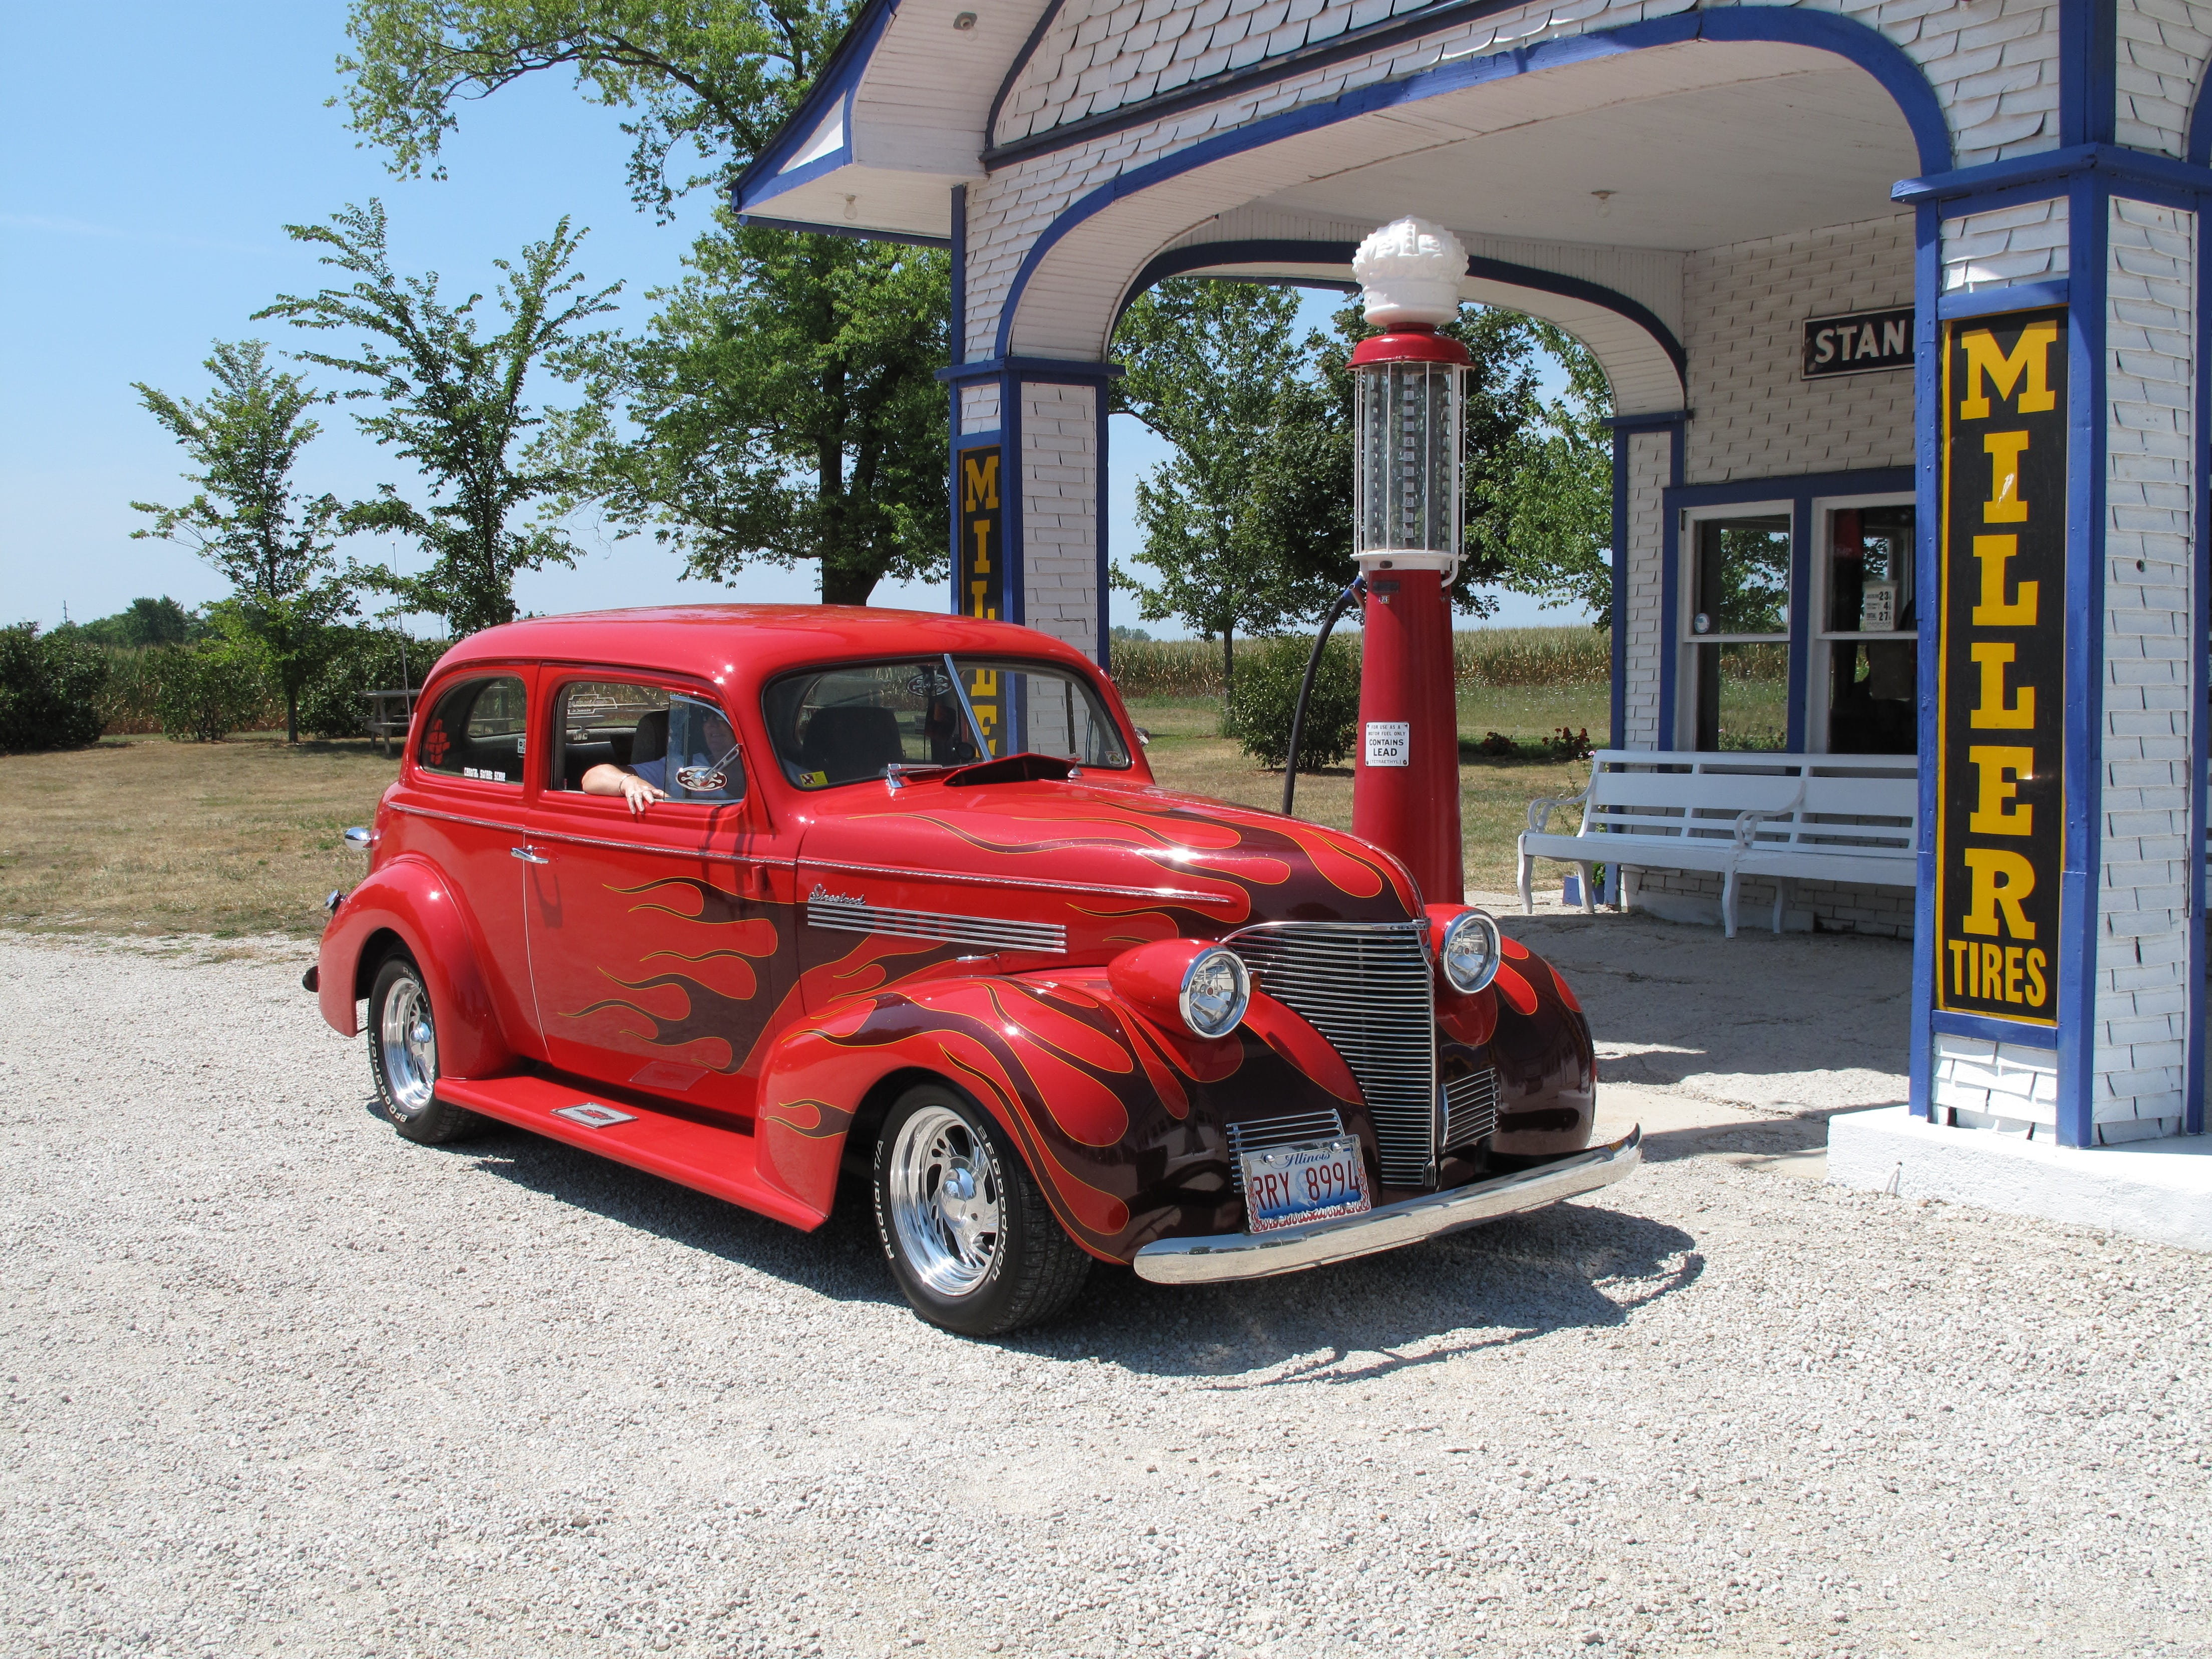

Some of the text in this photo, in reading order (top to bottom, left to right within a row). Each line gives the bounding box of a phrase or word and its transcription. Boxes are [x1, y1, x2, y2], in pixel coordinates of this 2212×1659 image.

[1815, 320, 1914, 363] STAN
[1406, 438, 1412, 446] 4
[1406, 452, 1412, 460] 5
[1879, 591, 1888, 601] 23
[1883, 602, 1888, 610] 4
[1879, 612, 1888, 621] 27
[1960, 320, 2057, 940] MILLER
[1373, 748, 1398, 756] LEAD
[1948, 939, 2047, 1007] TIRES
[1275, 1150, 1330, 1168] Illinois
[874, 1140, 895, 1259] Radial T/A
[977, 1125, 1008, 1281] BFGoodrich
